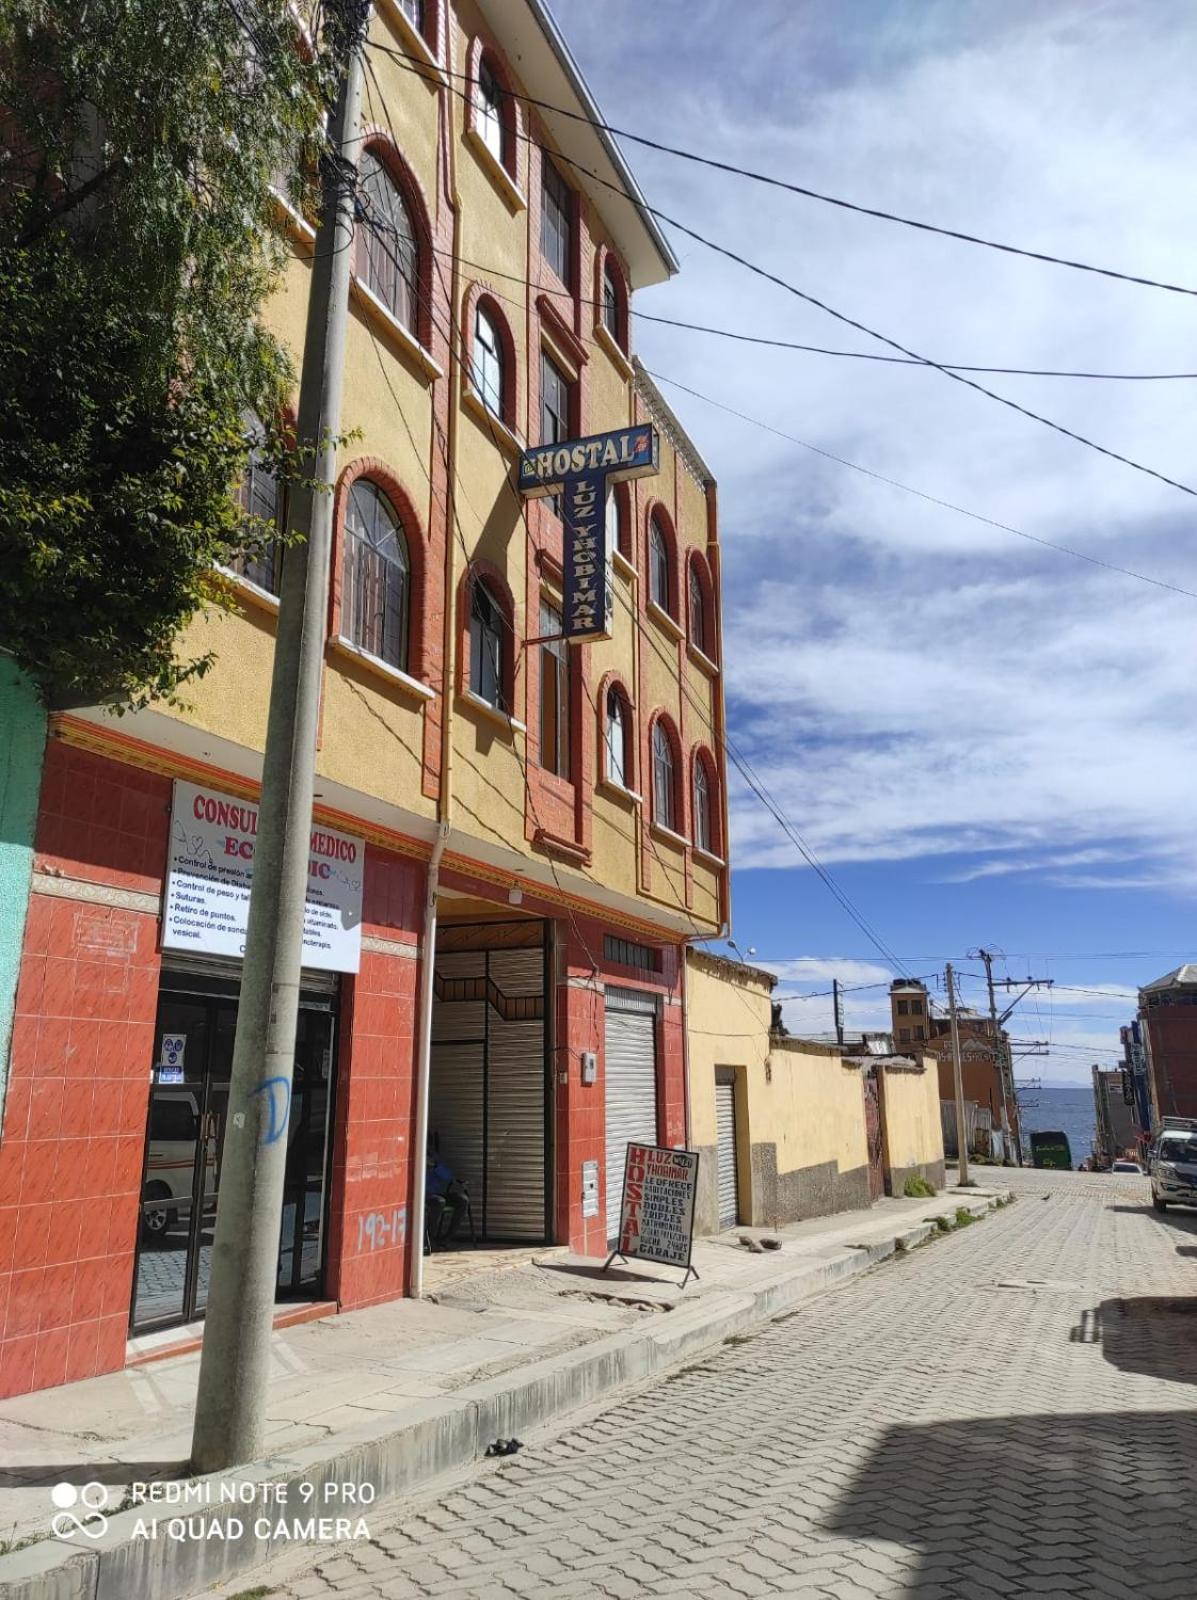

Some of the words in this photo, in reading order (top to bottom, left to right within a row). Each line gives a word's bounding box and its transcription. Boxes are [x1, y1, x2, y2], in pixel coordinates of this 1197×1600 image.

[536, 435, 635, 479] HOSTAL
[572, 480, 597, 519] LUZ
[178, 856, 206, 868] Control
[176, 880, 204, 891] Control
[217, 889, 234, 898] peso
[174, 904, 198, 914] Retiro
[173, 916, 216, 929] Colocación
[173, 929, 201, 938] vesical.
[648, 1151, 672, 1165] LUZ
[621, 1147, 647, 1255] HOSTAL
[645, 1193, 684, 1207] SIMPLES
[643, 1210, 682, 1224] TRIPLES
[640, 1244, 686, 1261] GARAJE
